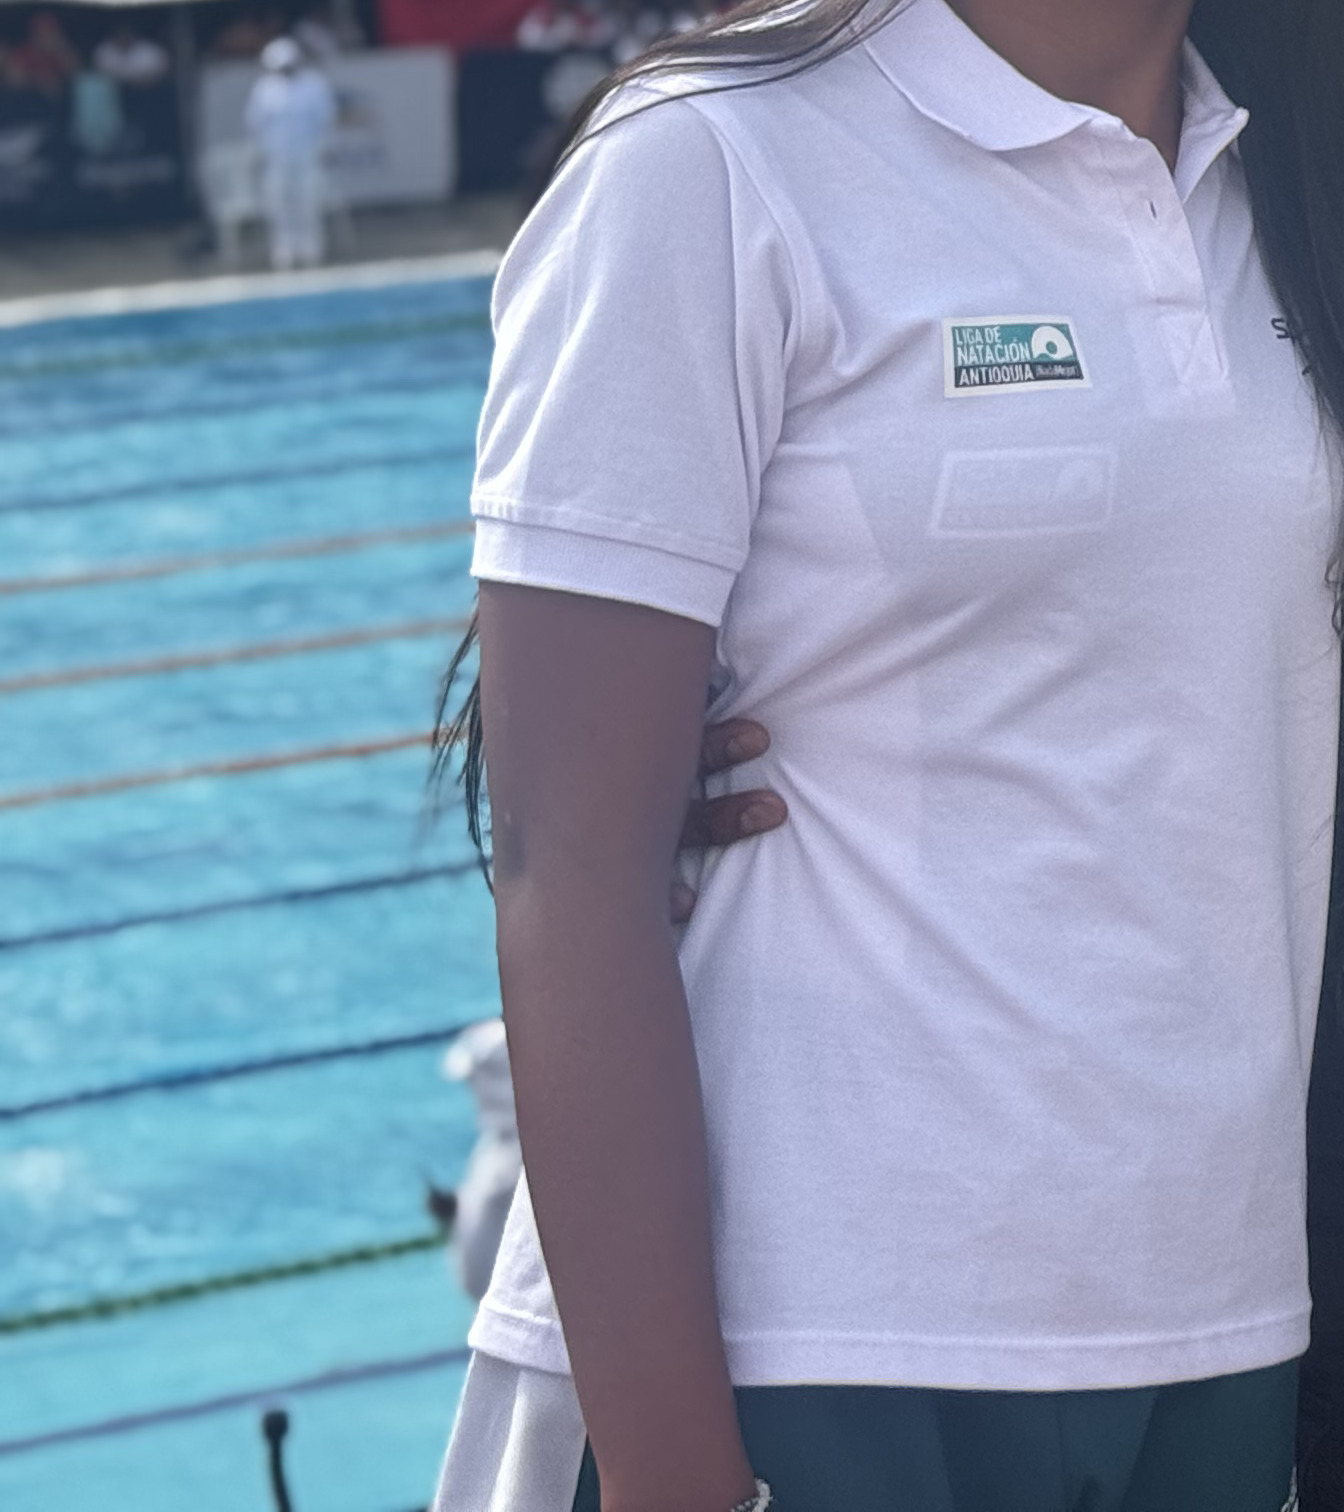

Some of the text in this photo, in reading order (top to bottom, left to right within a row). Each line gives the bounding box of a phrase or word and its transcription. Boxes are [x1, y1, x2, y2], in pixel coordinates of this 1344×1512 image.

[955, 326, 1002, 345] LIGA DE
[957, 337, 1031, 366] NATACIÓN
[959, 364, 1035, 386] ANTIOQUIA
